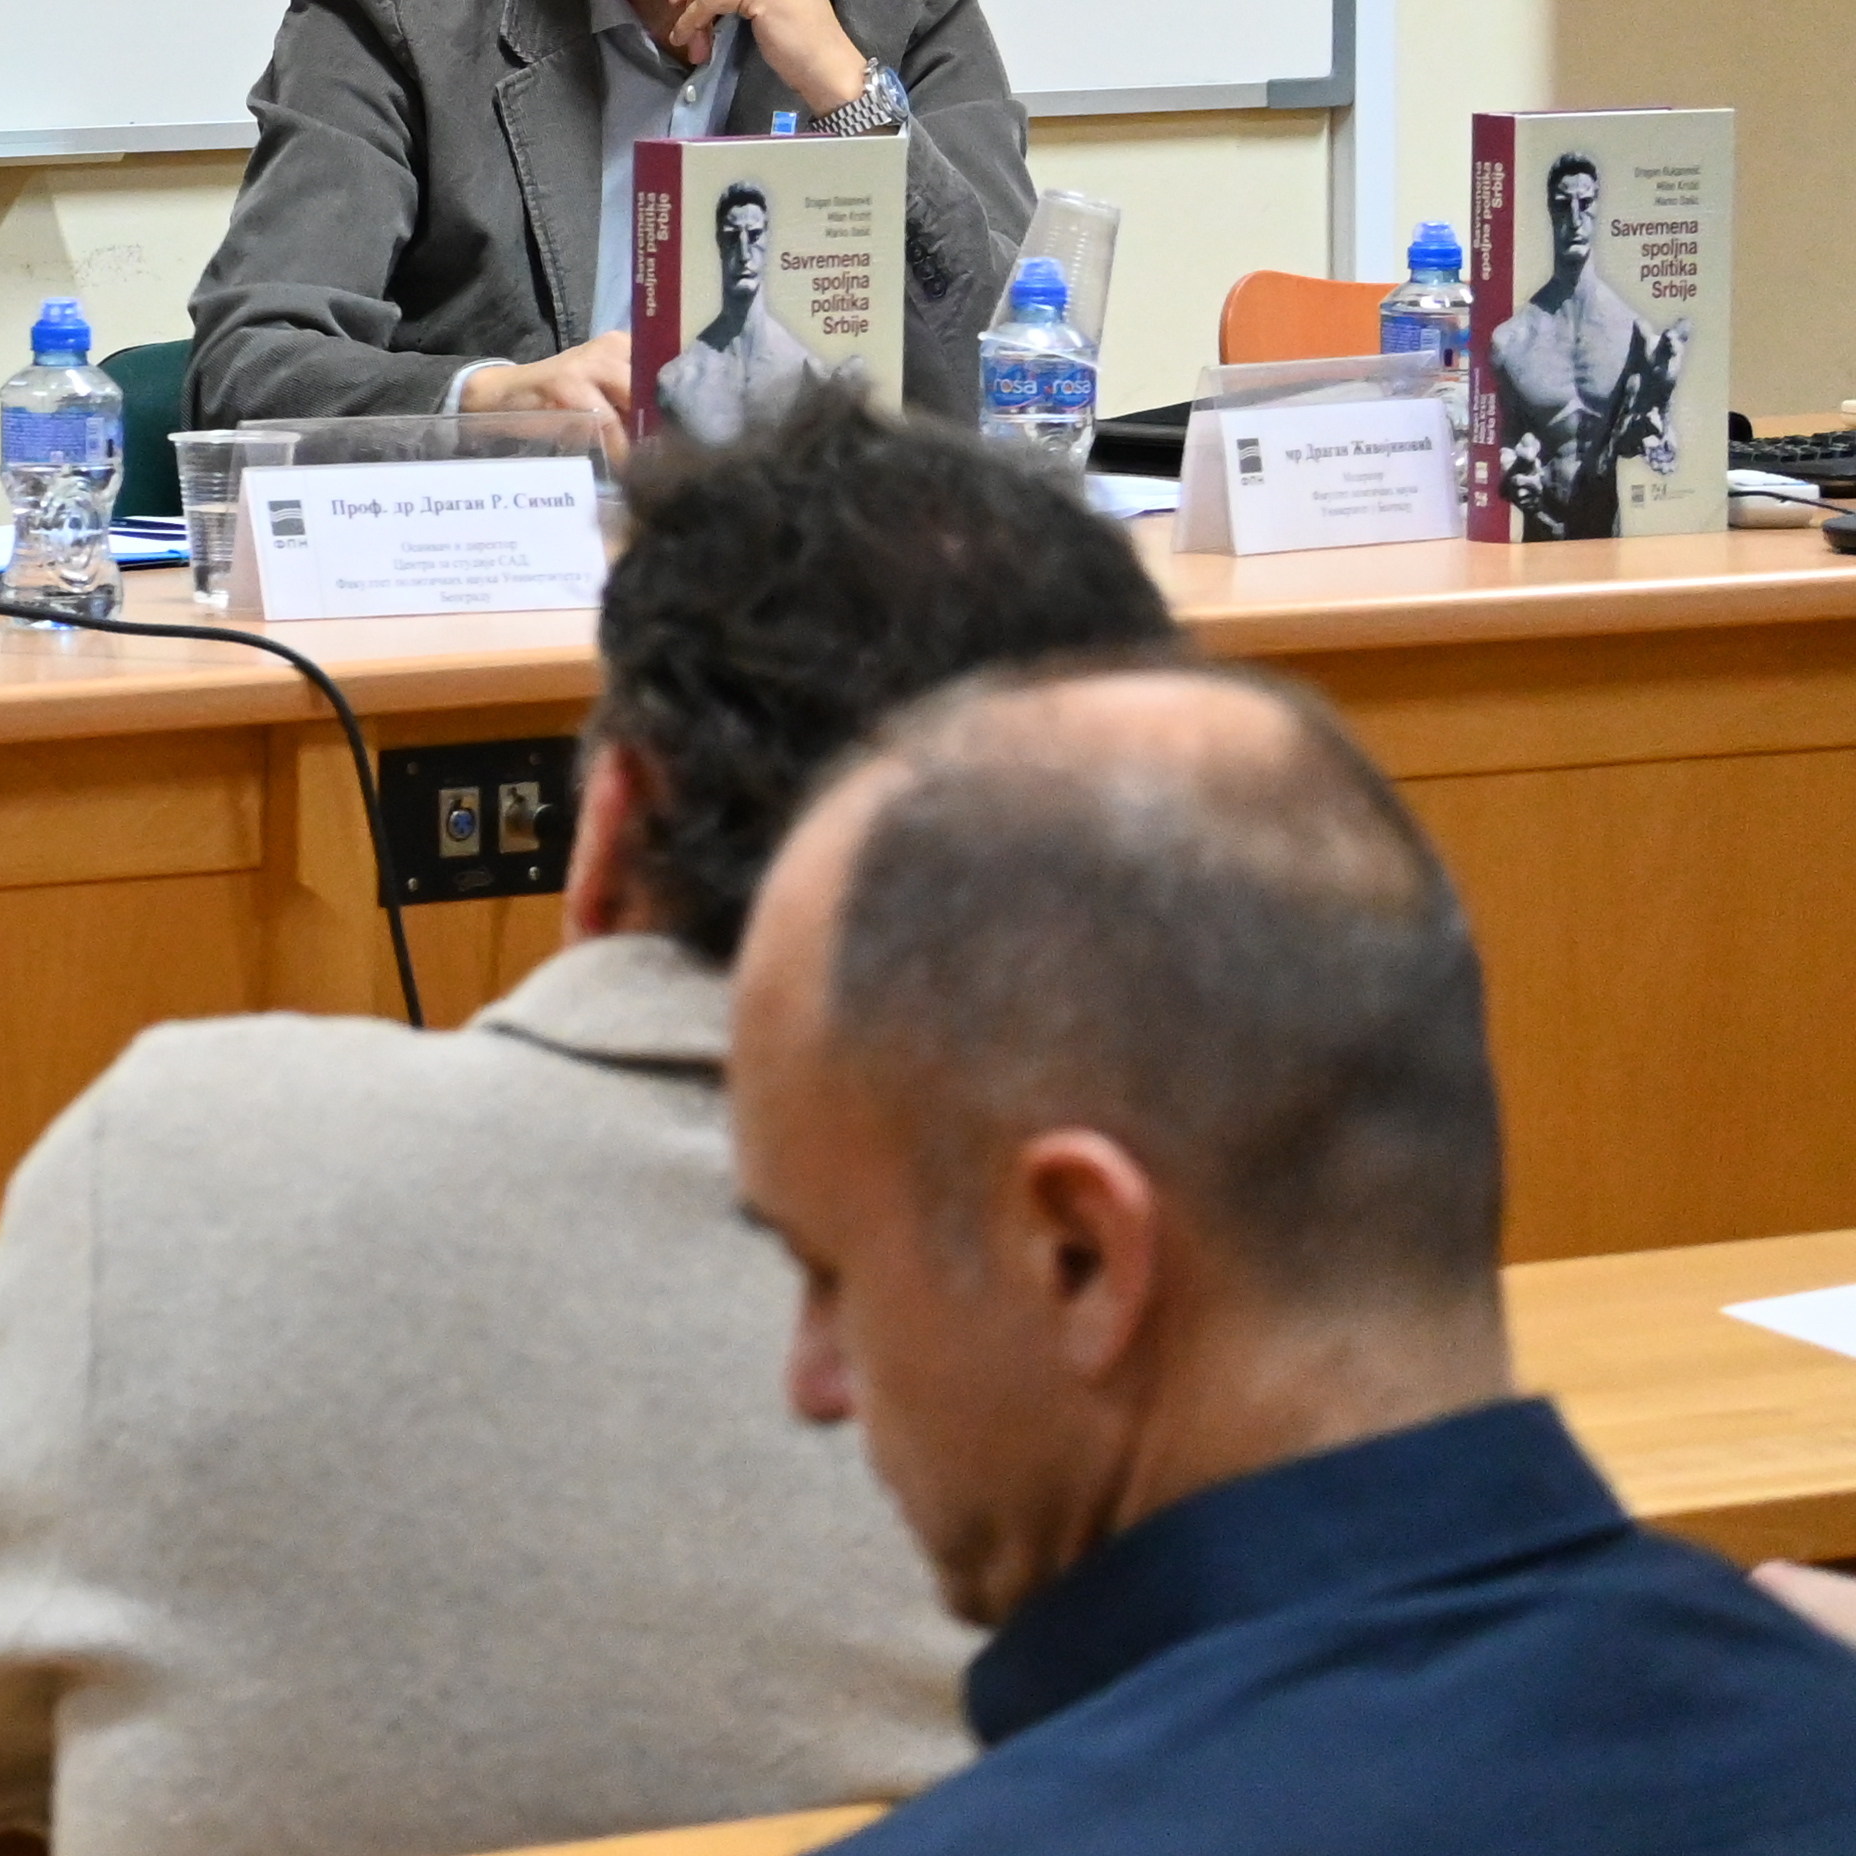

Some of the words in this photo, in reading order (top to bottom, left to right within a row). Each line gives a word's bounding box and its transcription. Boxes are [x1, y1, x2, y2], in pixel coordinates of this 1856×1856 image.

[656, 193, 672, 241] Srbije
[1611, 219, 1699, 237] Savremena
[1641, 238, 1698, 260] spoljna
[780, 251, 870, 270] Savremena
[1640, 258, 1697, 282] politika
[812, 271, 869, 294] spoljna
[1652, 279, 1697, 301] Srbije
[811, 294, 869, 317] politika
[823, 315, 869, 337] Srbije
[993, 377, 1037, 394] rosa
[1052, 379, 1091, 394] rosa
[1306, 443, 1348, 463] Драган
[331, 498, 388, 520] Проф.
[394, 501, 415, 518] др
[420, 496, 485, 516] Драган
[491, 494, 508, 510] Р.
[513, 492, 575, 509] Симић
